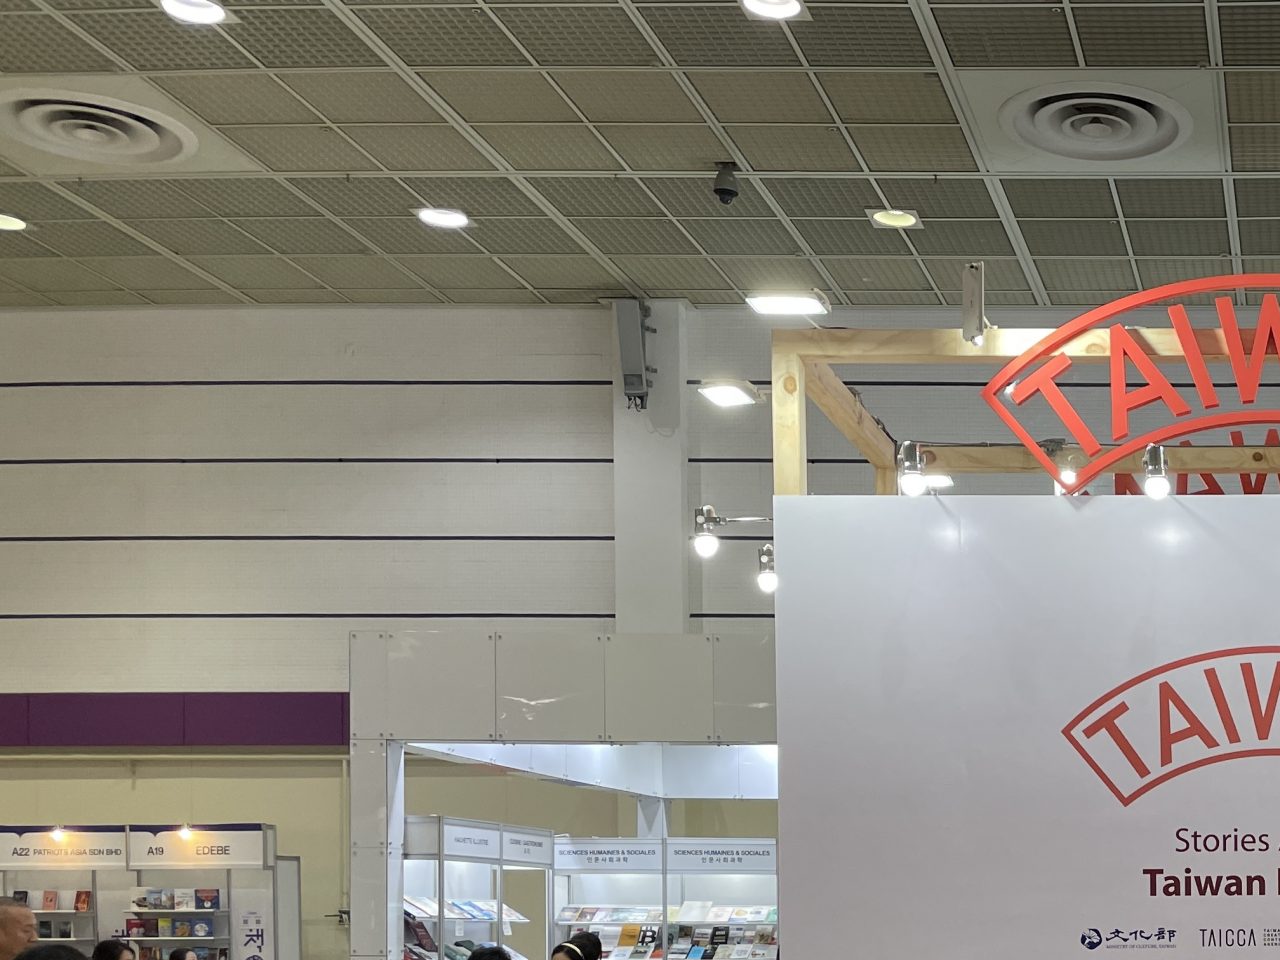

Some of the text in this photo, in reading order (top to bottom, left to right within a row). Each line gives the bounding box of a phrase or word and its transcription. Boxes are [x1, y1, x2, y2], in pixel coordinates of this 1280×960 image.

[1174, 828, 1270, 853] Stories
[12, 847, 30, 857] A22
[147, 845, 231, 856] A19 EDEBE
[1142, 868, 1266, 897] Taiwan
[1105, 927, 1177, 943] 文化部
[1200, 928, 1257, 947] TAICCA
